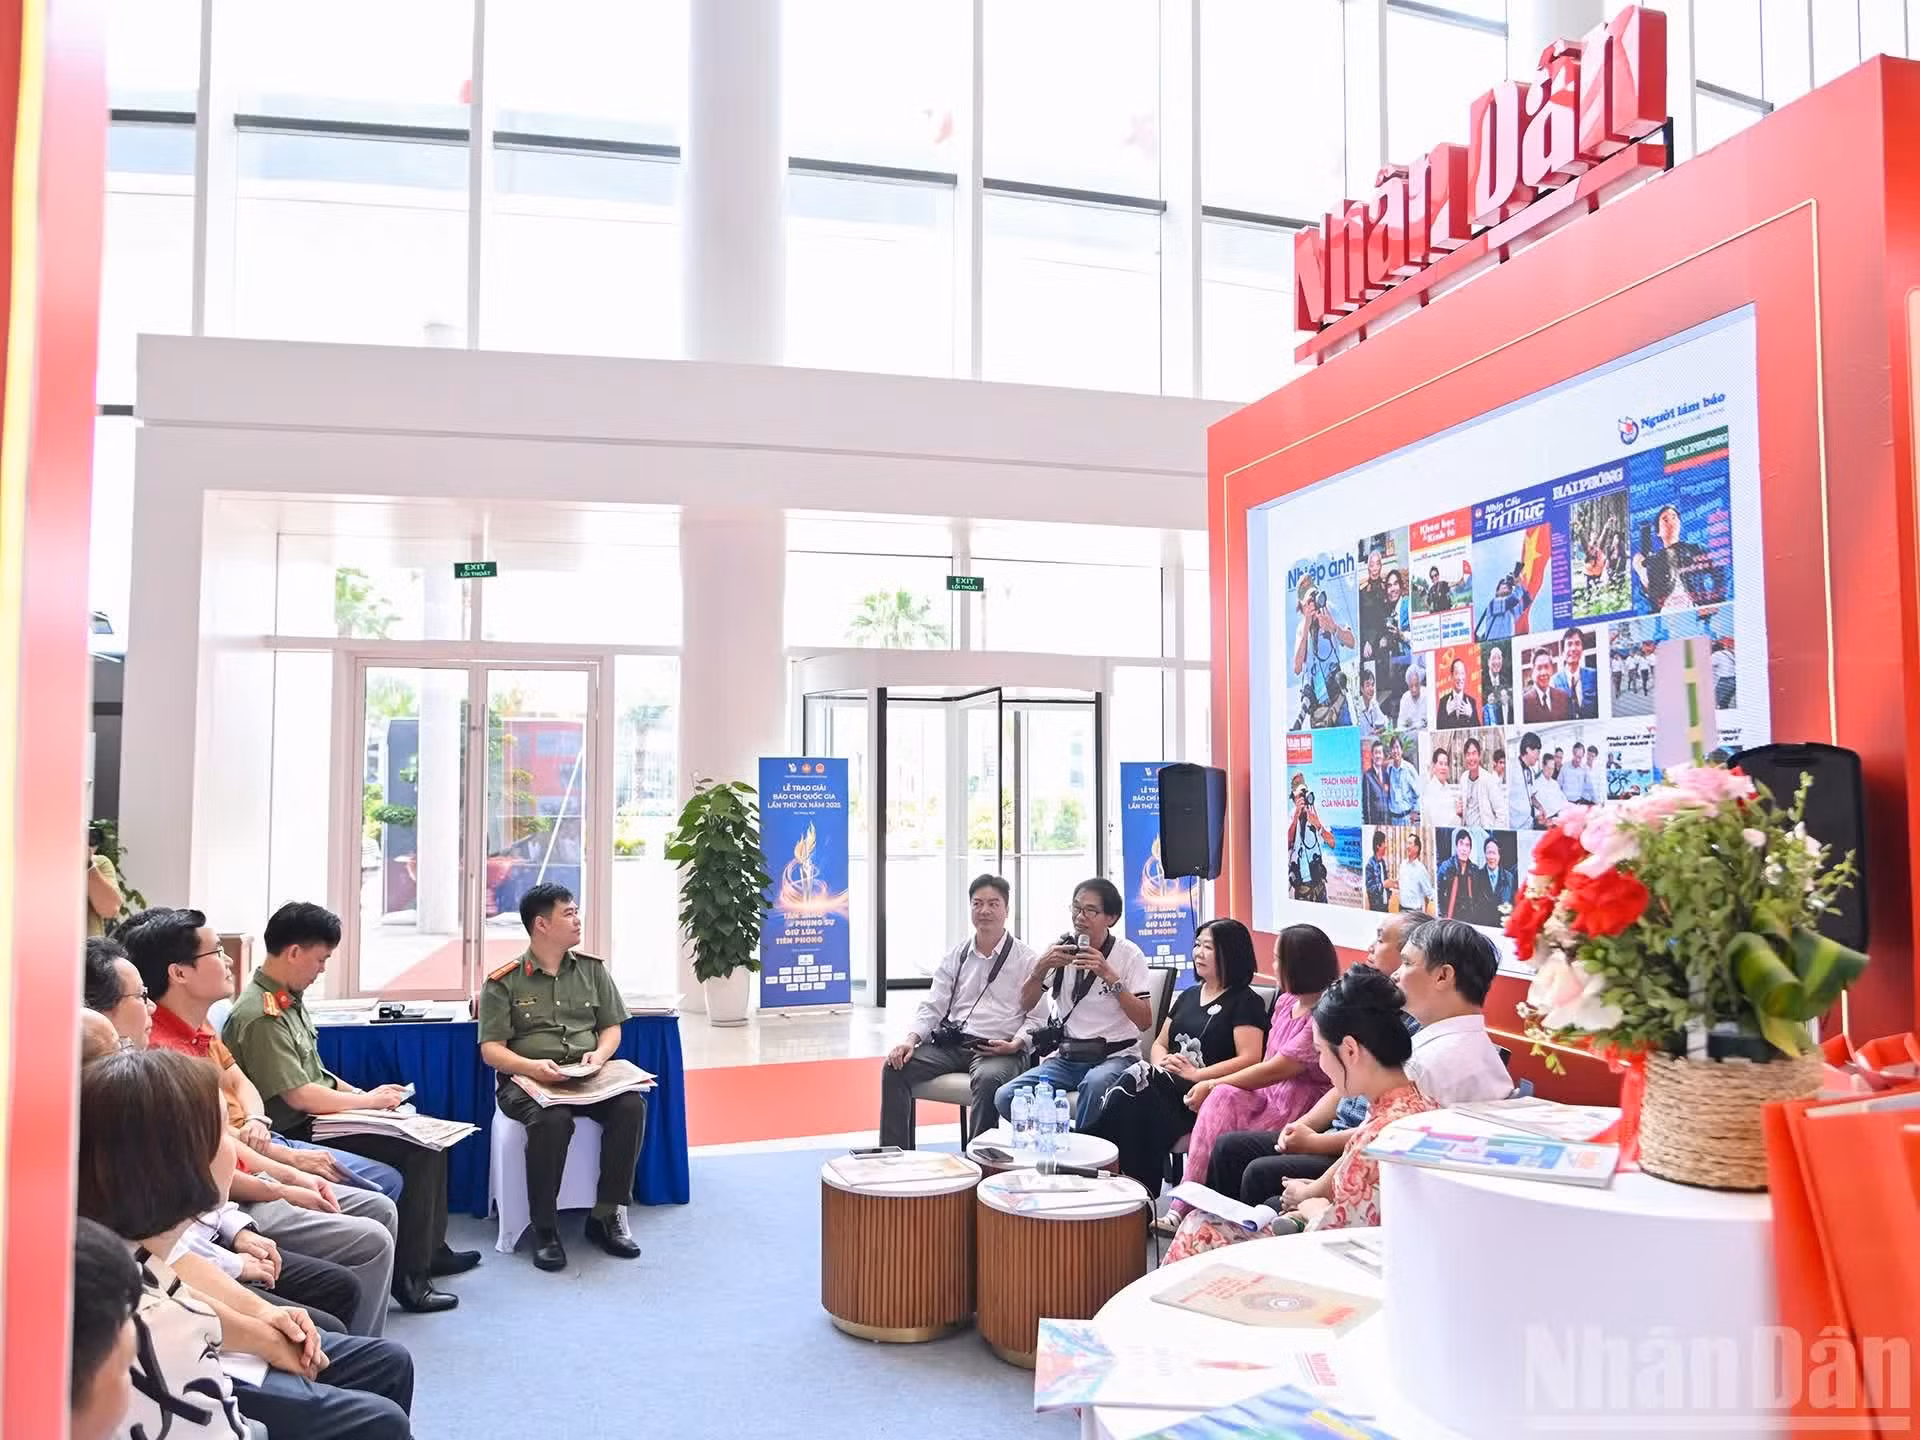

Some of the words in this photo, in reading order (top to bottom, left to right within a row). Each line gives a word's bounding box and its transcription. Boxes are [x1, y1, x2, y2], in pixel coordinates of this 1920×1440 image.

[1295, 143, 1472, 332] Nhân
[1471, 4, 1668, 226] Dân
[1640, 408, 1675, 429] Người
[773, 792, 788, 800] BÁO
[802, 792, 823, 800] QUỐC
